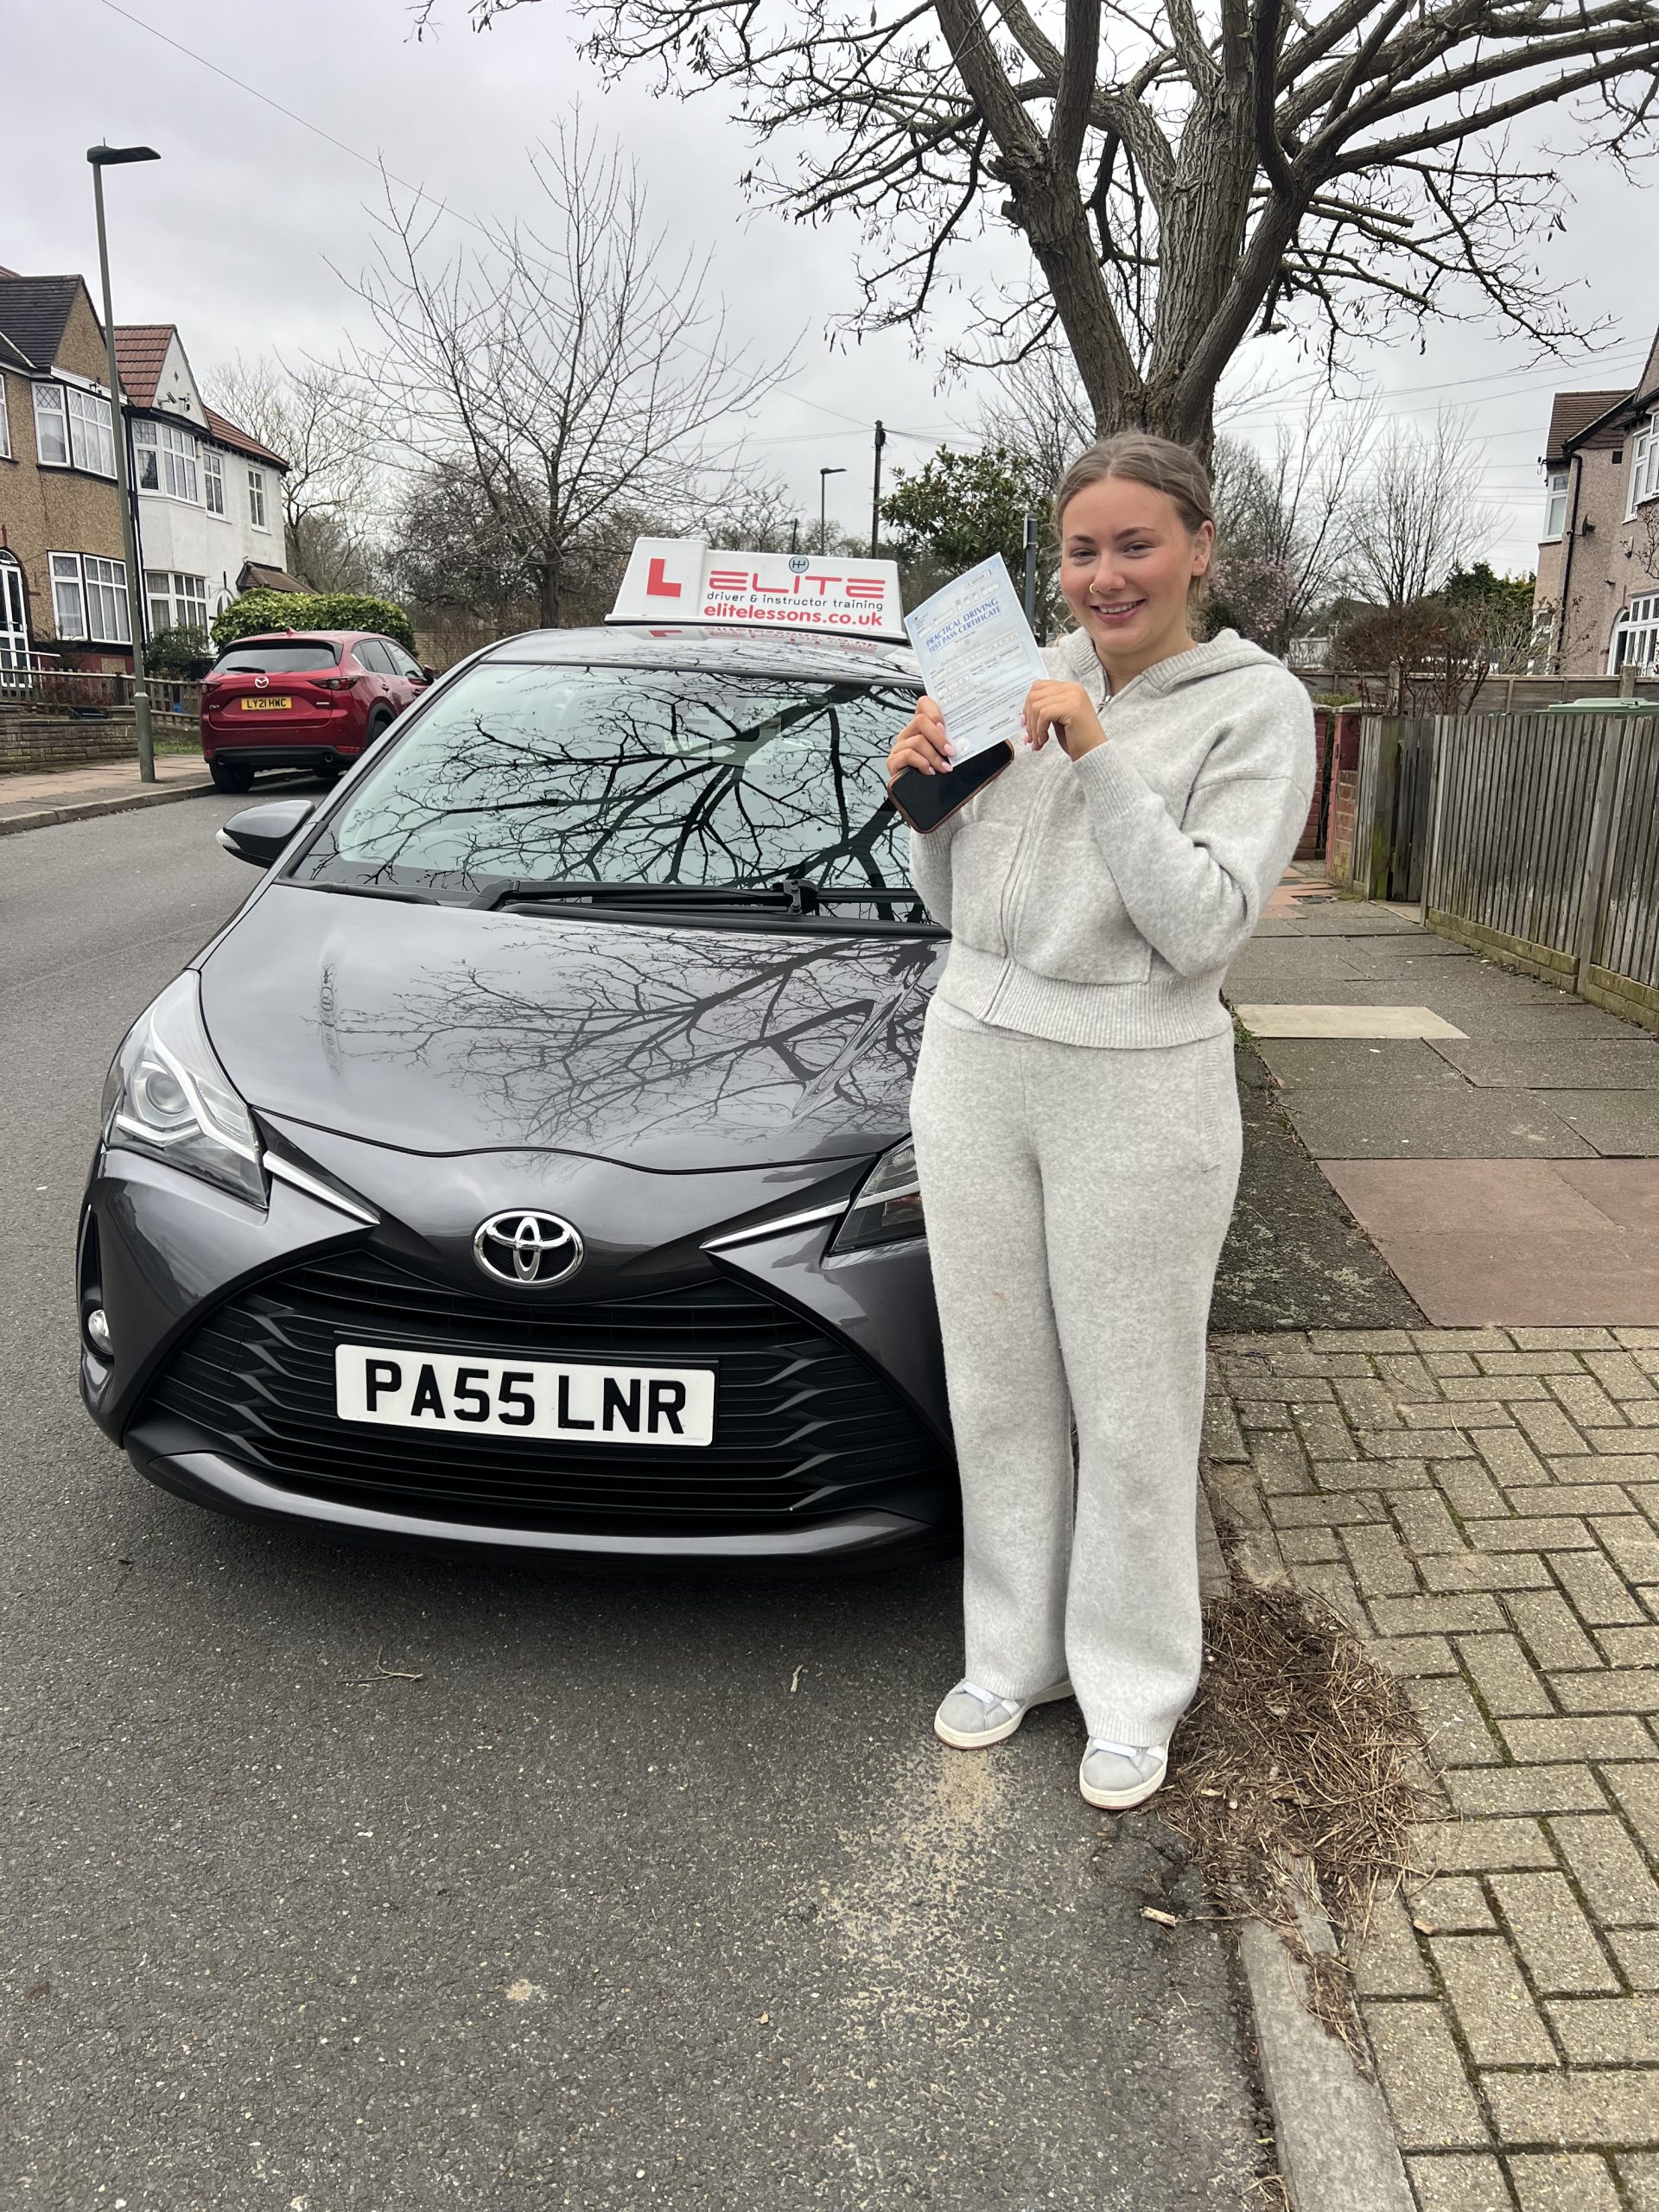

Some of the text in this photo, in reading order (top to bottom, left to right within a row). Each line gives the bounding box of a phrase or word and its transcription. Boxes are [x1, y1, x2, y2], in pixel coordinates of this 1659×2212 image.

[646, 558, 682, 597] L
[709, 570, 886, 599] ELITE
[704, 603, 882, 626] elitelessons.co.uk
[707, 591, 745, 601] driver
[763, 594, 828, 607] instructor
[833, 599, 883, 612] training
[926, 619, 961, 647] PRACTICAL
[963, 597, 998, 622] DRIVING
[929, 641, 941, 654] TEST
[942, 632, 957, 644] PASS
[958, 606, 1001, 633] CERTIFICATE
[246, 698, 287, 709] LY21 HWC
[365, 1358, 686, 1434] PA55 LNR
